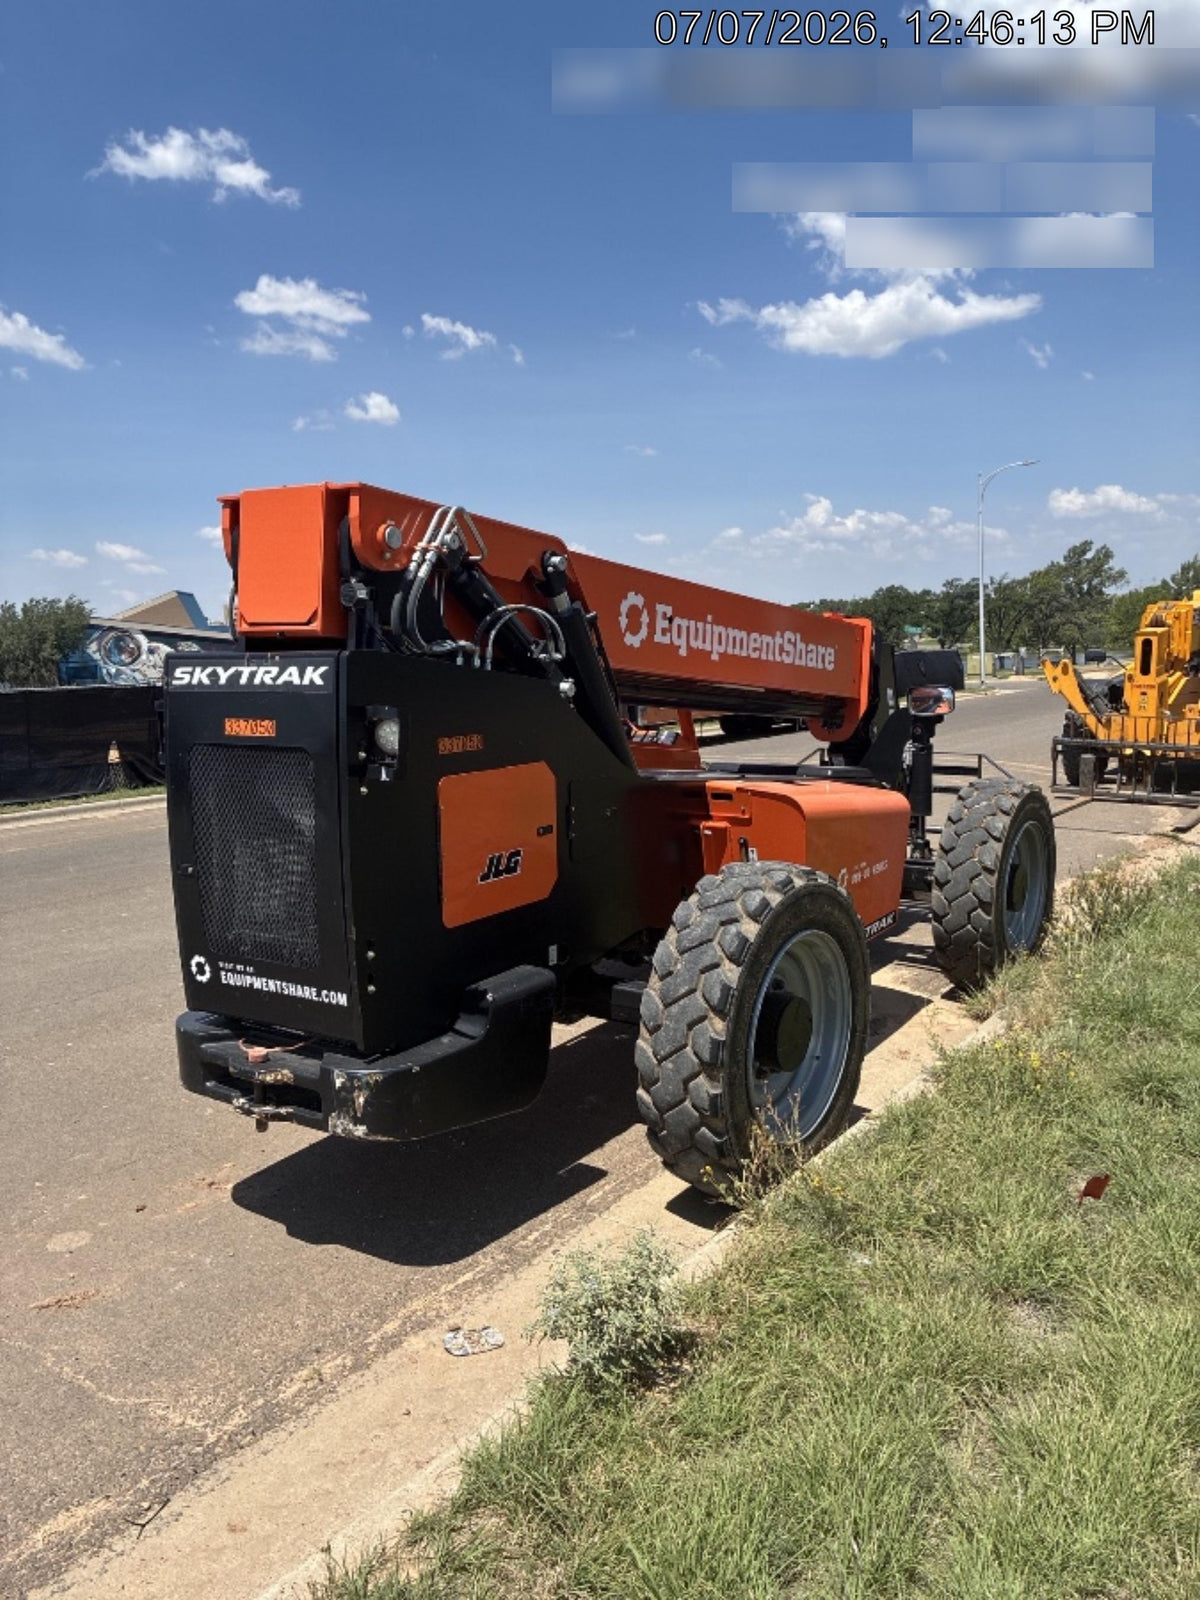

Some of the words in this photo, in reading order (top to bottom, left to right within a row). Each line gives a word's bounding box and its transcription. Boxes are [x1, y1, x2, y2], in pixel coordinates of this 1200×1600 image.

[654, 603, 835, 671] EquipmentShare
[172, 666, 329, 685] SKYTRAK
[478, 848, 523, 884] JLG
[864, 911, 894, 937] TRAK
[221, 970, 348, 1006] EQUIPMENTSHARE.COM
